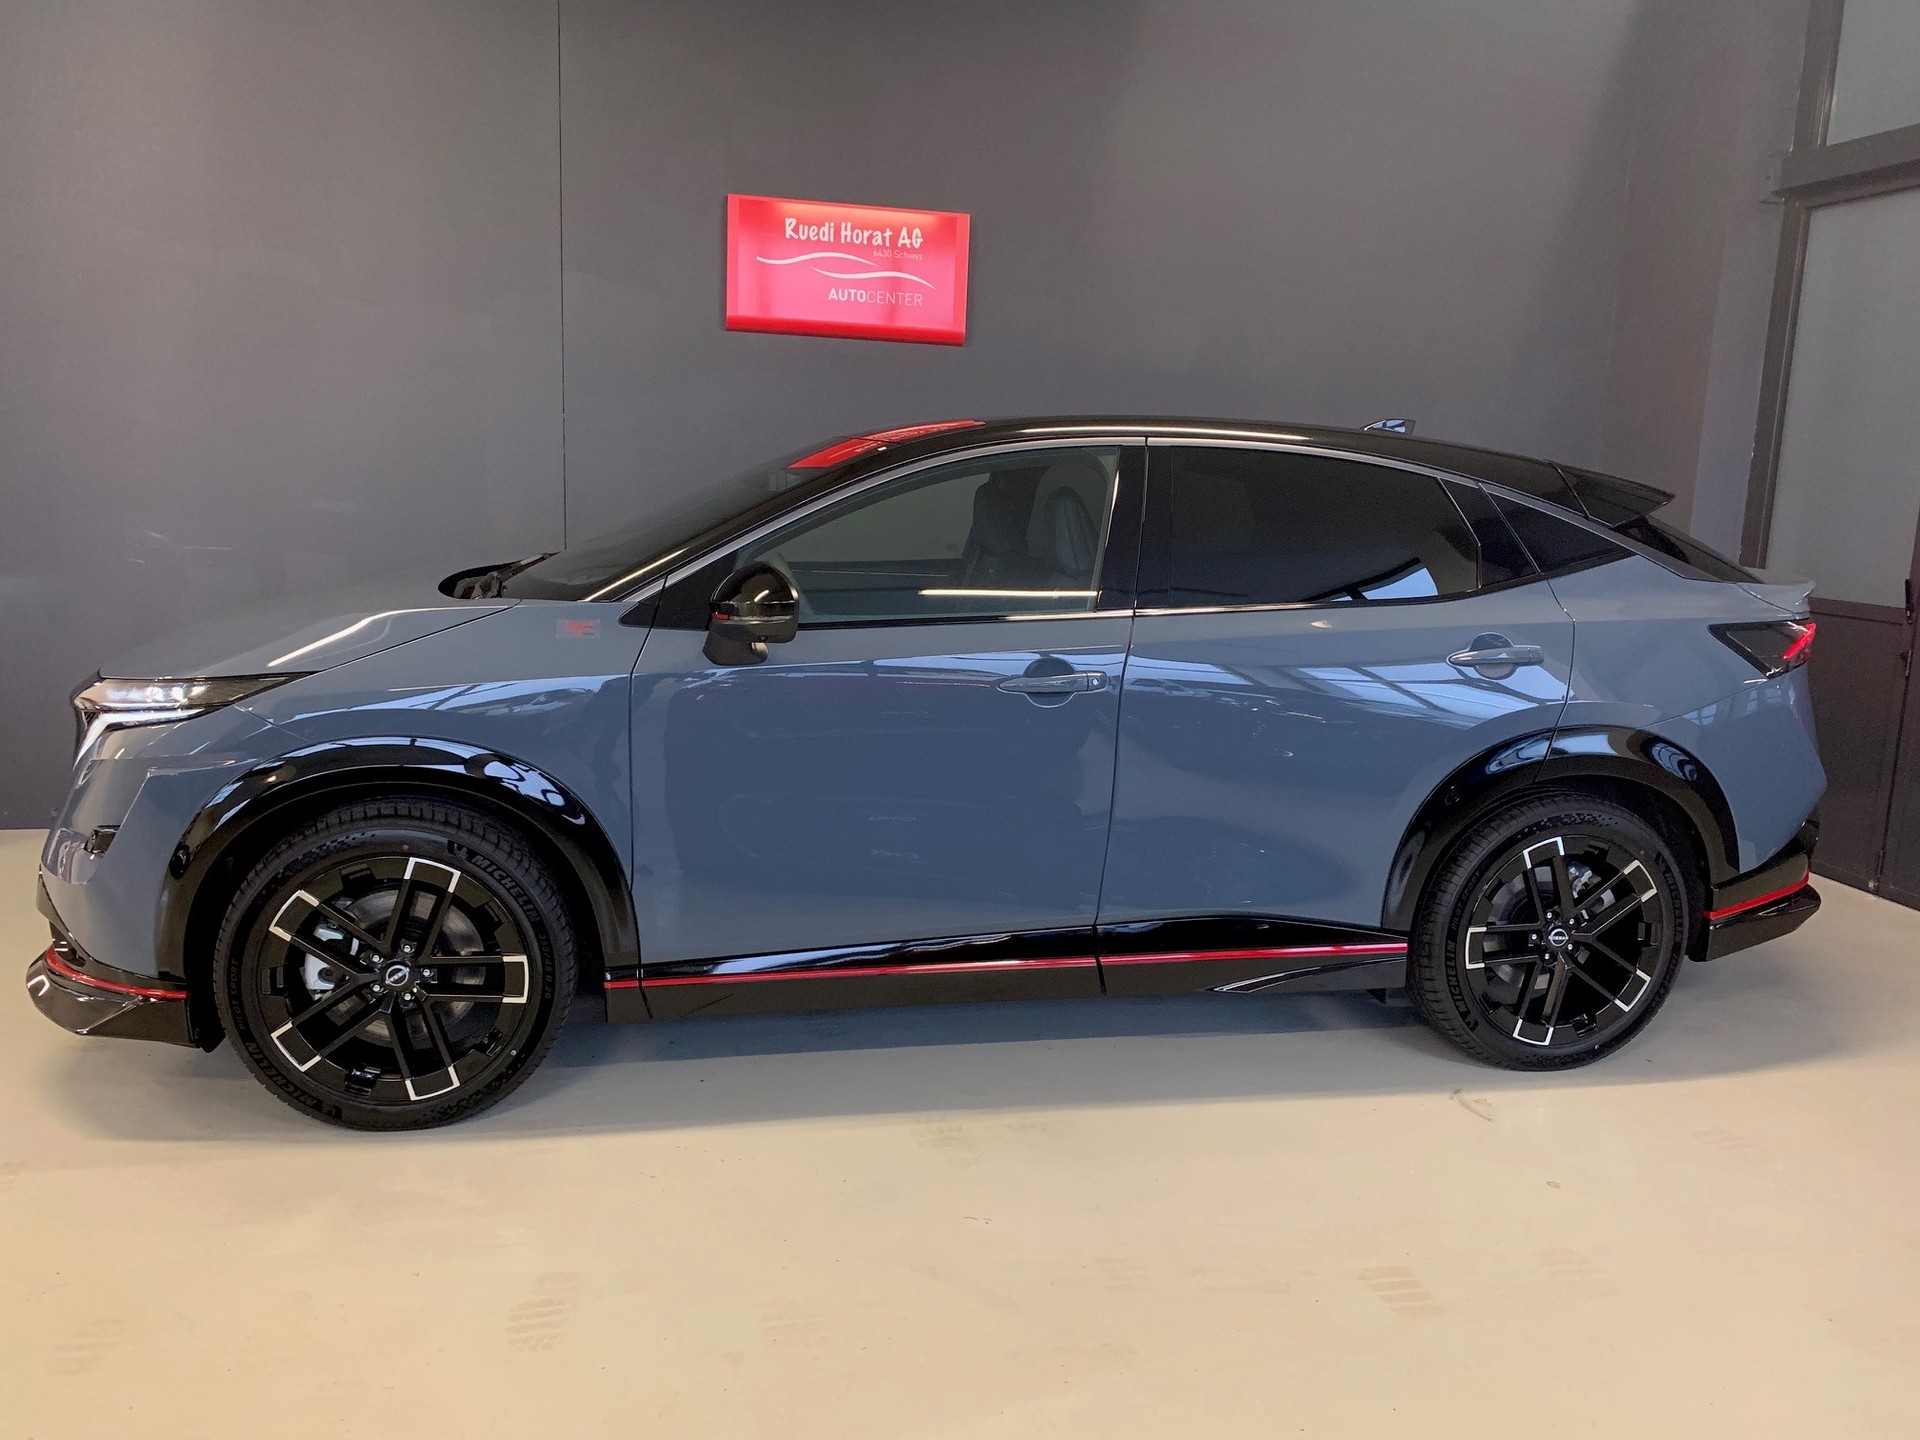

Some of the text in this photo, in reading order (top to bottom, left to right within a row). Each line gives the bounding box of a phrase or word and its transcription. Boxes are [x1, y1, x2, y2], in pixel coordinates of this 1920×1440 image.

[785, 217, 924, 249] Ruedi Horat AG
[872, 249, 924, 262] 6430 Schwyz
[828, 287, 923, 307] AUTOCENTER
[471, 853, 541, 923] MICHELIN
[229, 957, 248, 1031] PILOT SPORT
[1446, 940, 1470, 1015] MICHELIN
[246, 1042, 318, 1107] MICHELIN
